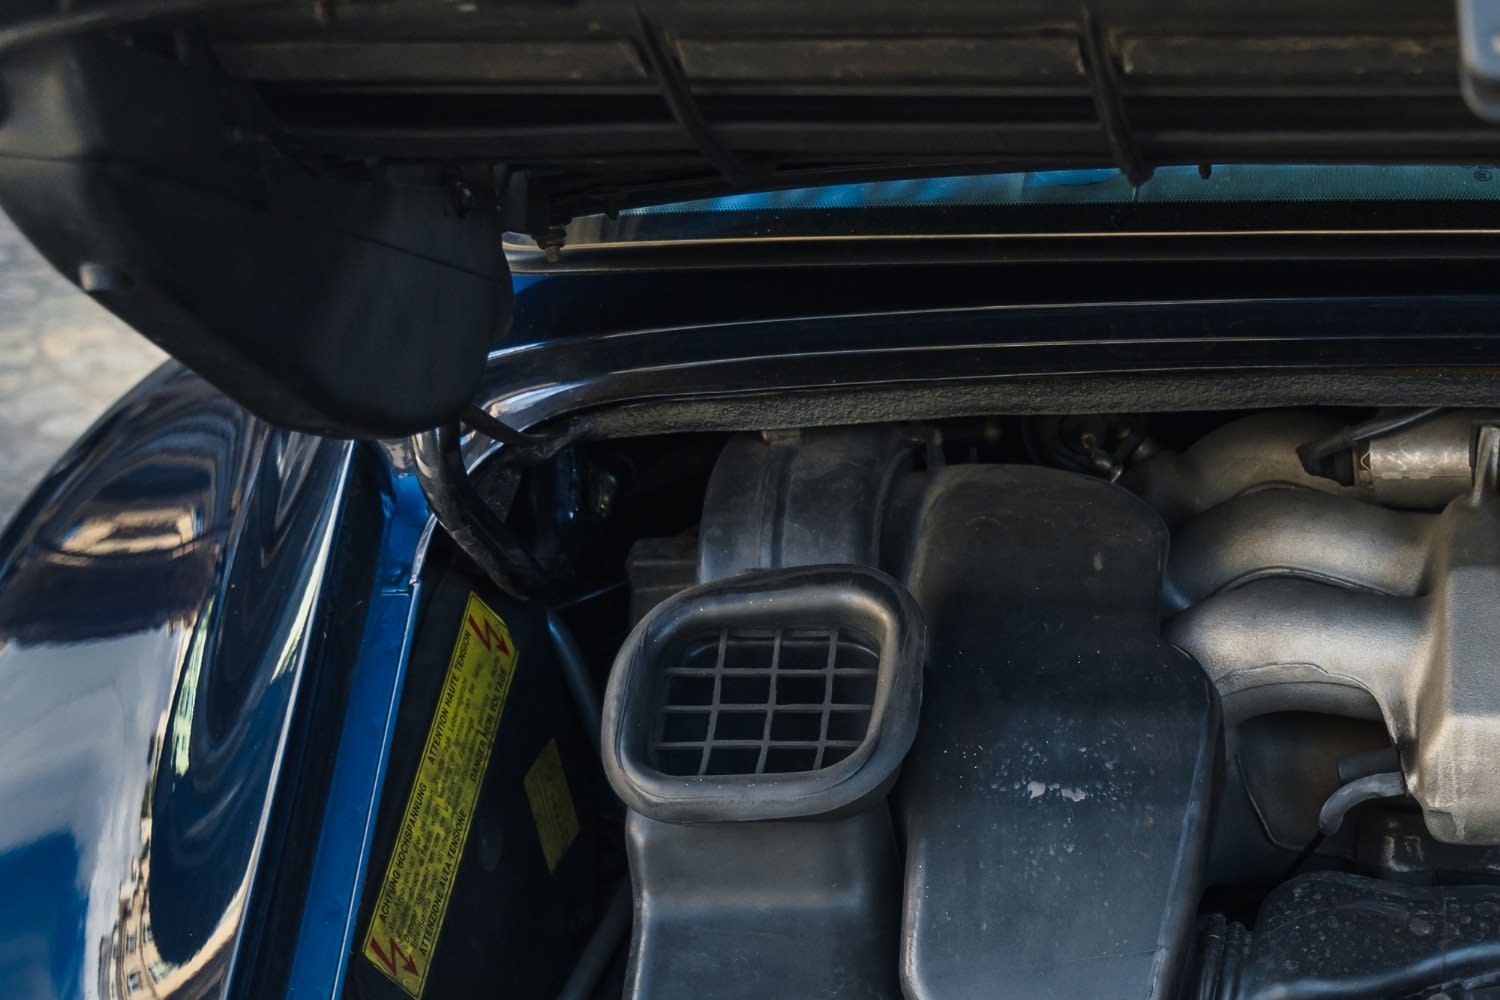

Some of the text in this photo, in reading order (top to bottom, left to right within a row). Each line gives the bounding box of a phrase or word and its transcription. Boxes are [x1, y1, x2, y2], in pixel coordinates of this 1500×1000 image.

[427, 631, 472, 765] ATTENTION HAUTE TENSION
[470, 739, 487, 782] DANGER
[491, 669, 507, 712] VOLTAGE
[379, 783, 427, 924] ACHTUNG HOCHSPANNUNG
[420, 809, 467, 955] ATTENZIONE ALTA TENSIONE
